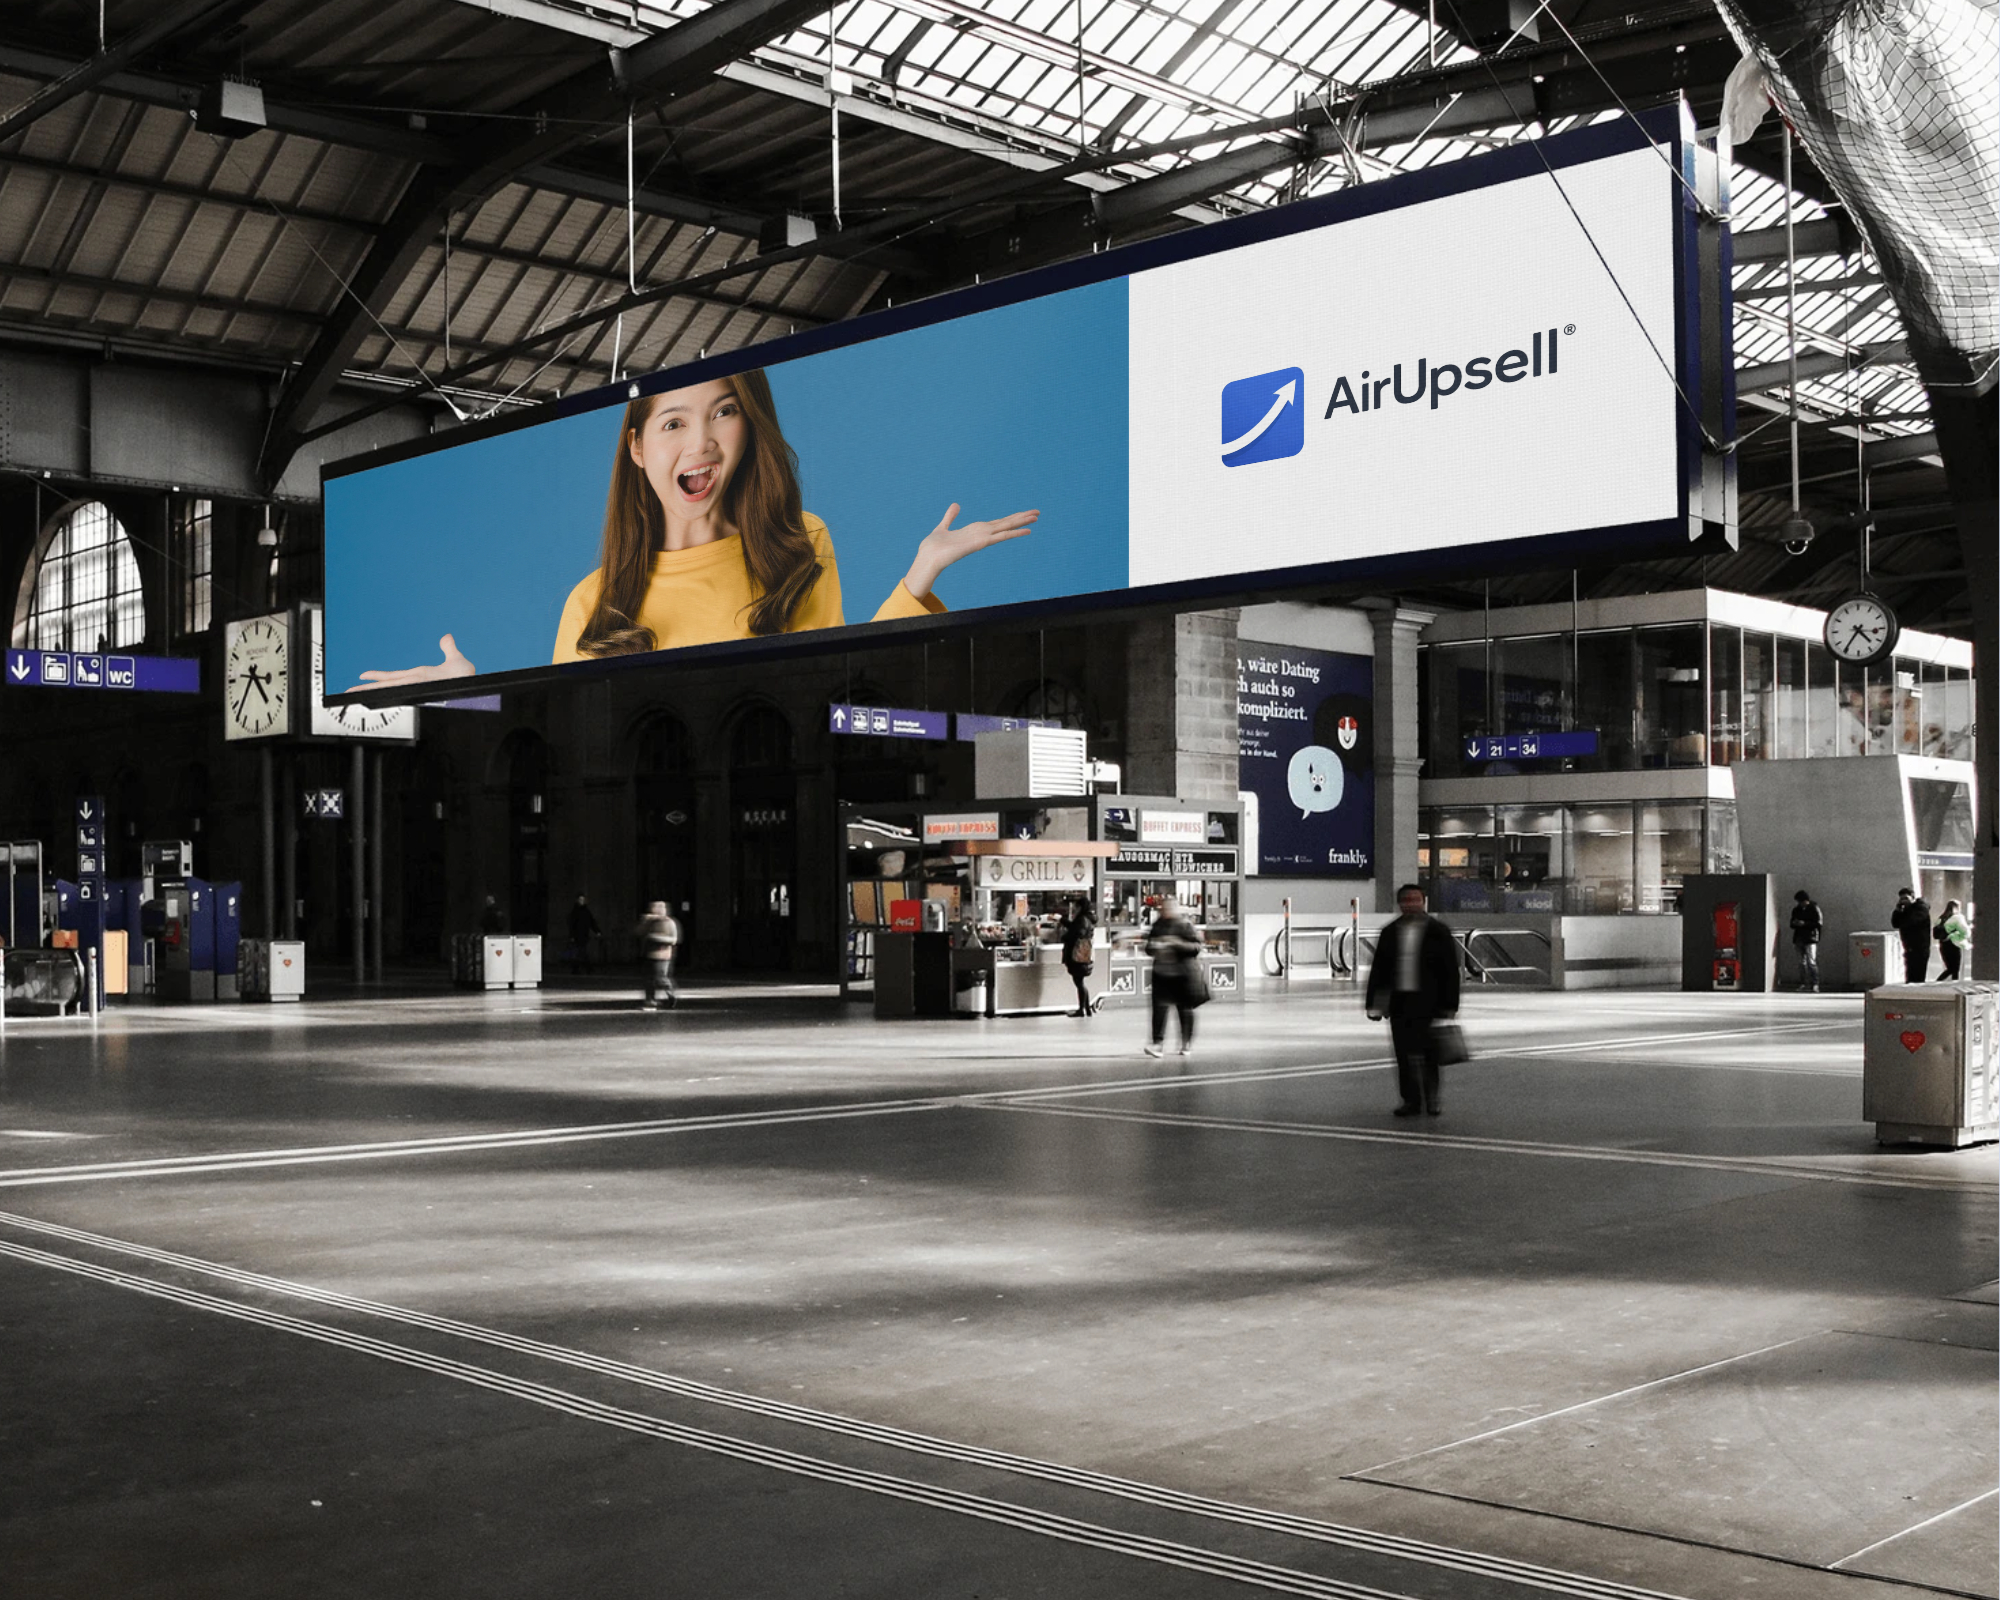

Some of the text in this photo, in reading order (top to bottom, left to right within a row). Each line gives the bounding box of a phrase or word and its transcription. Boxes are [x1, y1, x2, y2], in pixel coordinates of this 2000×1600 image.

[109, 671, 132, 685] WC
[1247, 656, 1278, 673] wäre
[1281, 659, 1320, 683] Dating
[1251, 679, 1279, 696] auch
[1282, 686, 1295, 697] so
[1490, 745, 1502, 756] 21
[1522, 743, 1536, 755] 34
[1143, 820, 1202, 833] BUFFET EXPRESS
[1328, 848, 1367, 868] frankly.
[1011, 859, 1064, 881] GRILL
